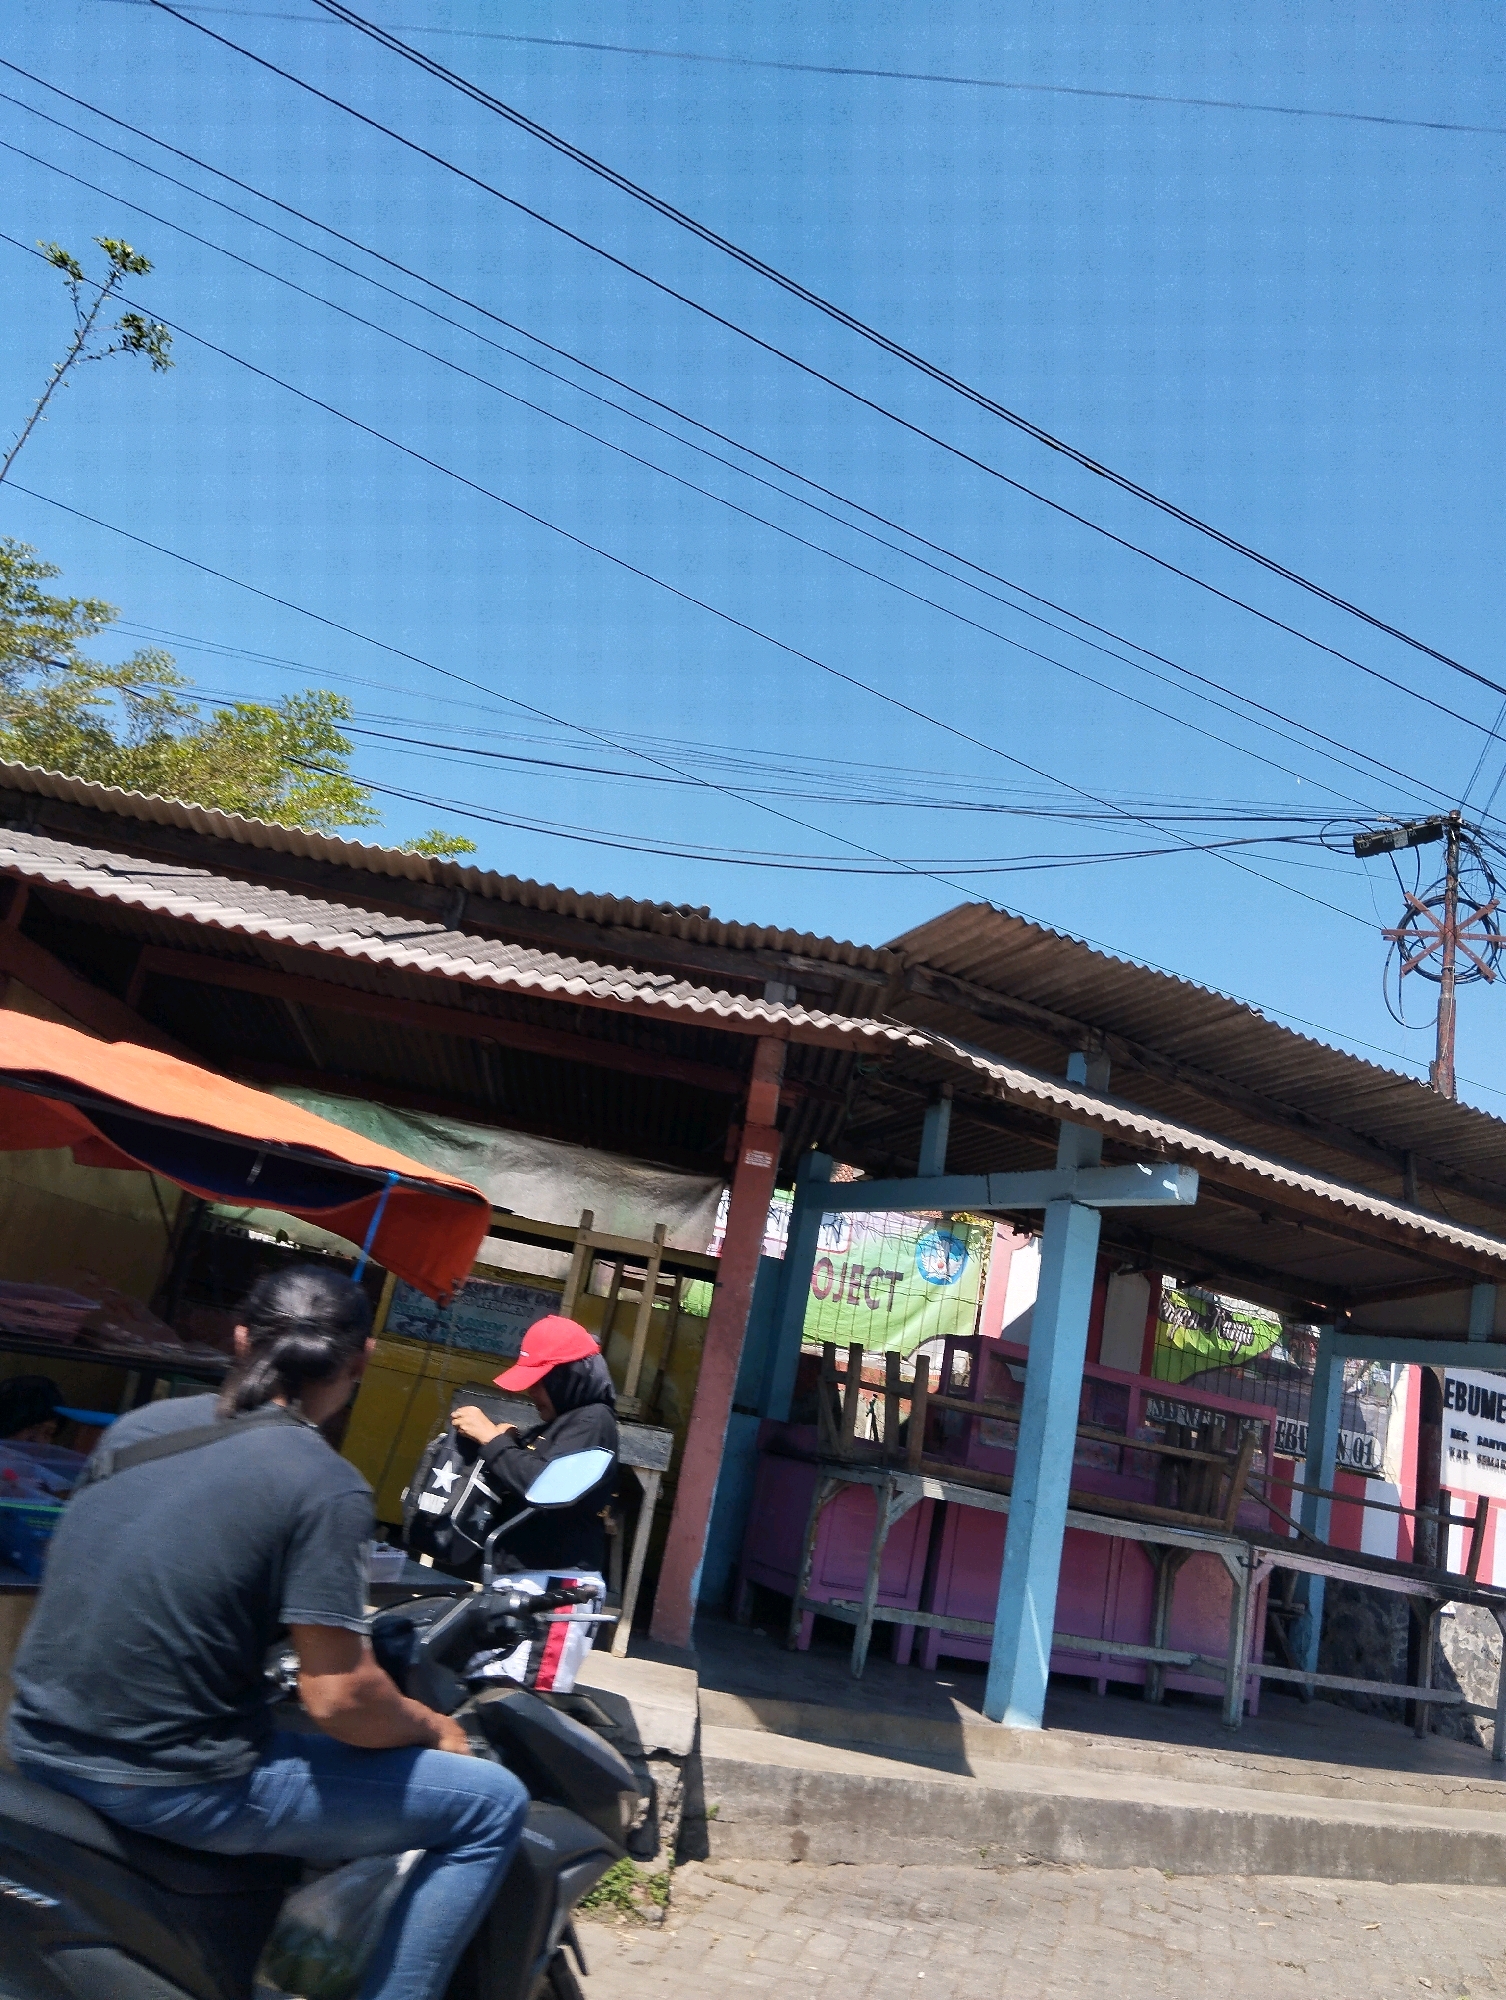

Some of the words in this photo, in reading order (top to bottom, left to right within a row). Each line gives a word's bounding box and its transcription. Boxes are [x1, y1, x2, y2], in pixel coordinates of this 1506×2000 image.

[811, 1256, 904, 1312] OJECT
[1443, 1377, 1506, 1423] EBUME
[1352, 1437, 1374, 1466] 01
